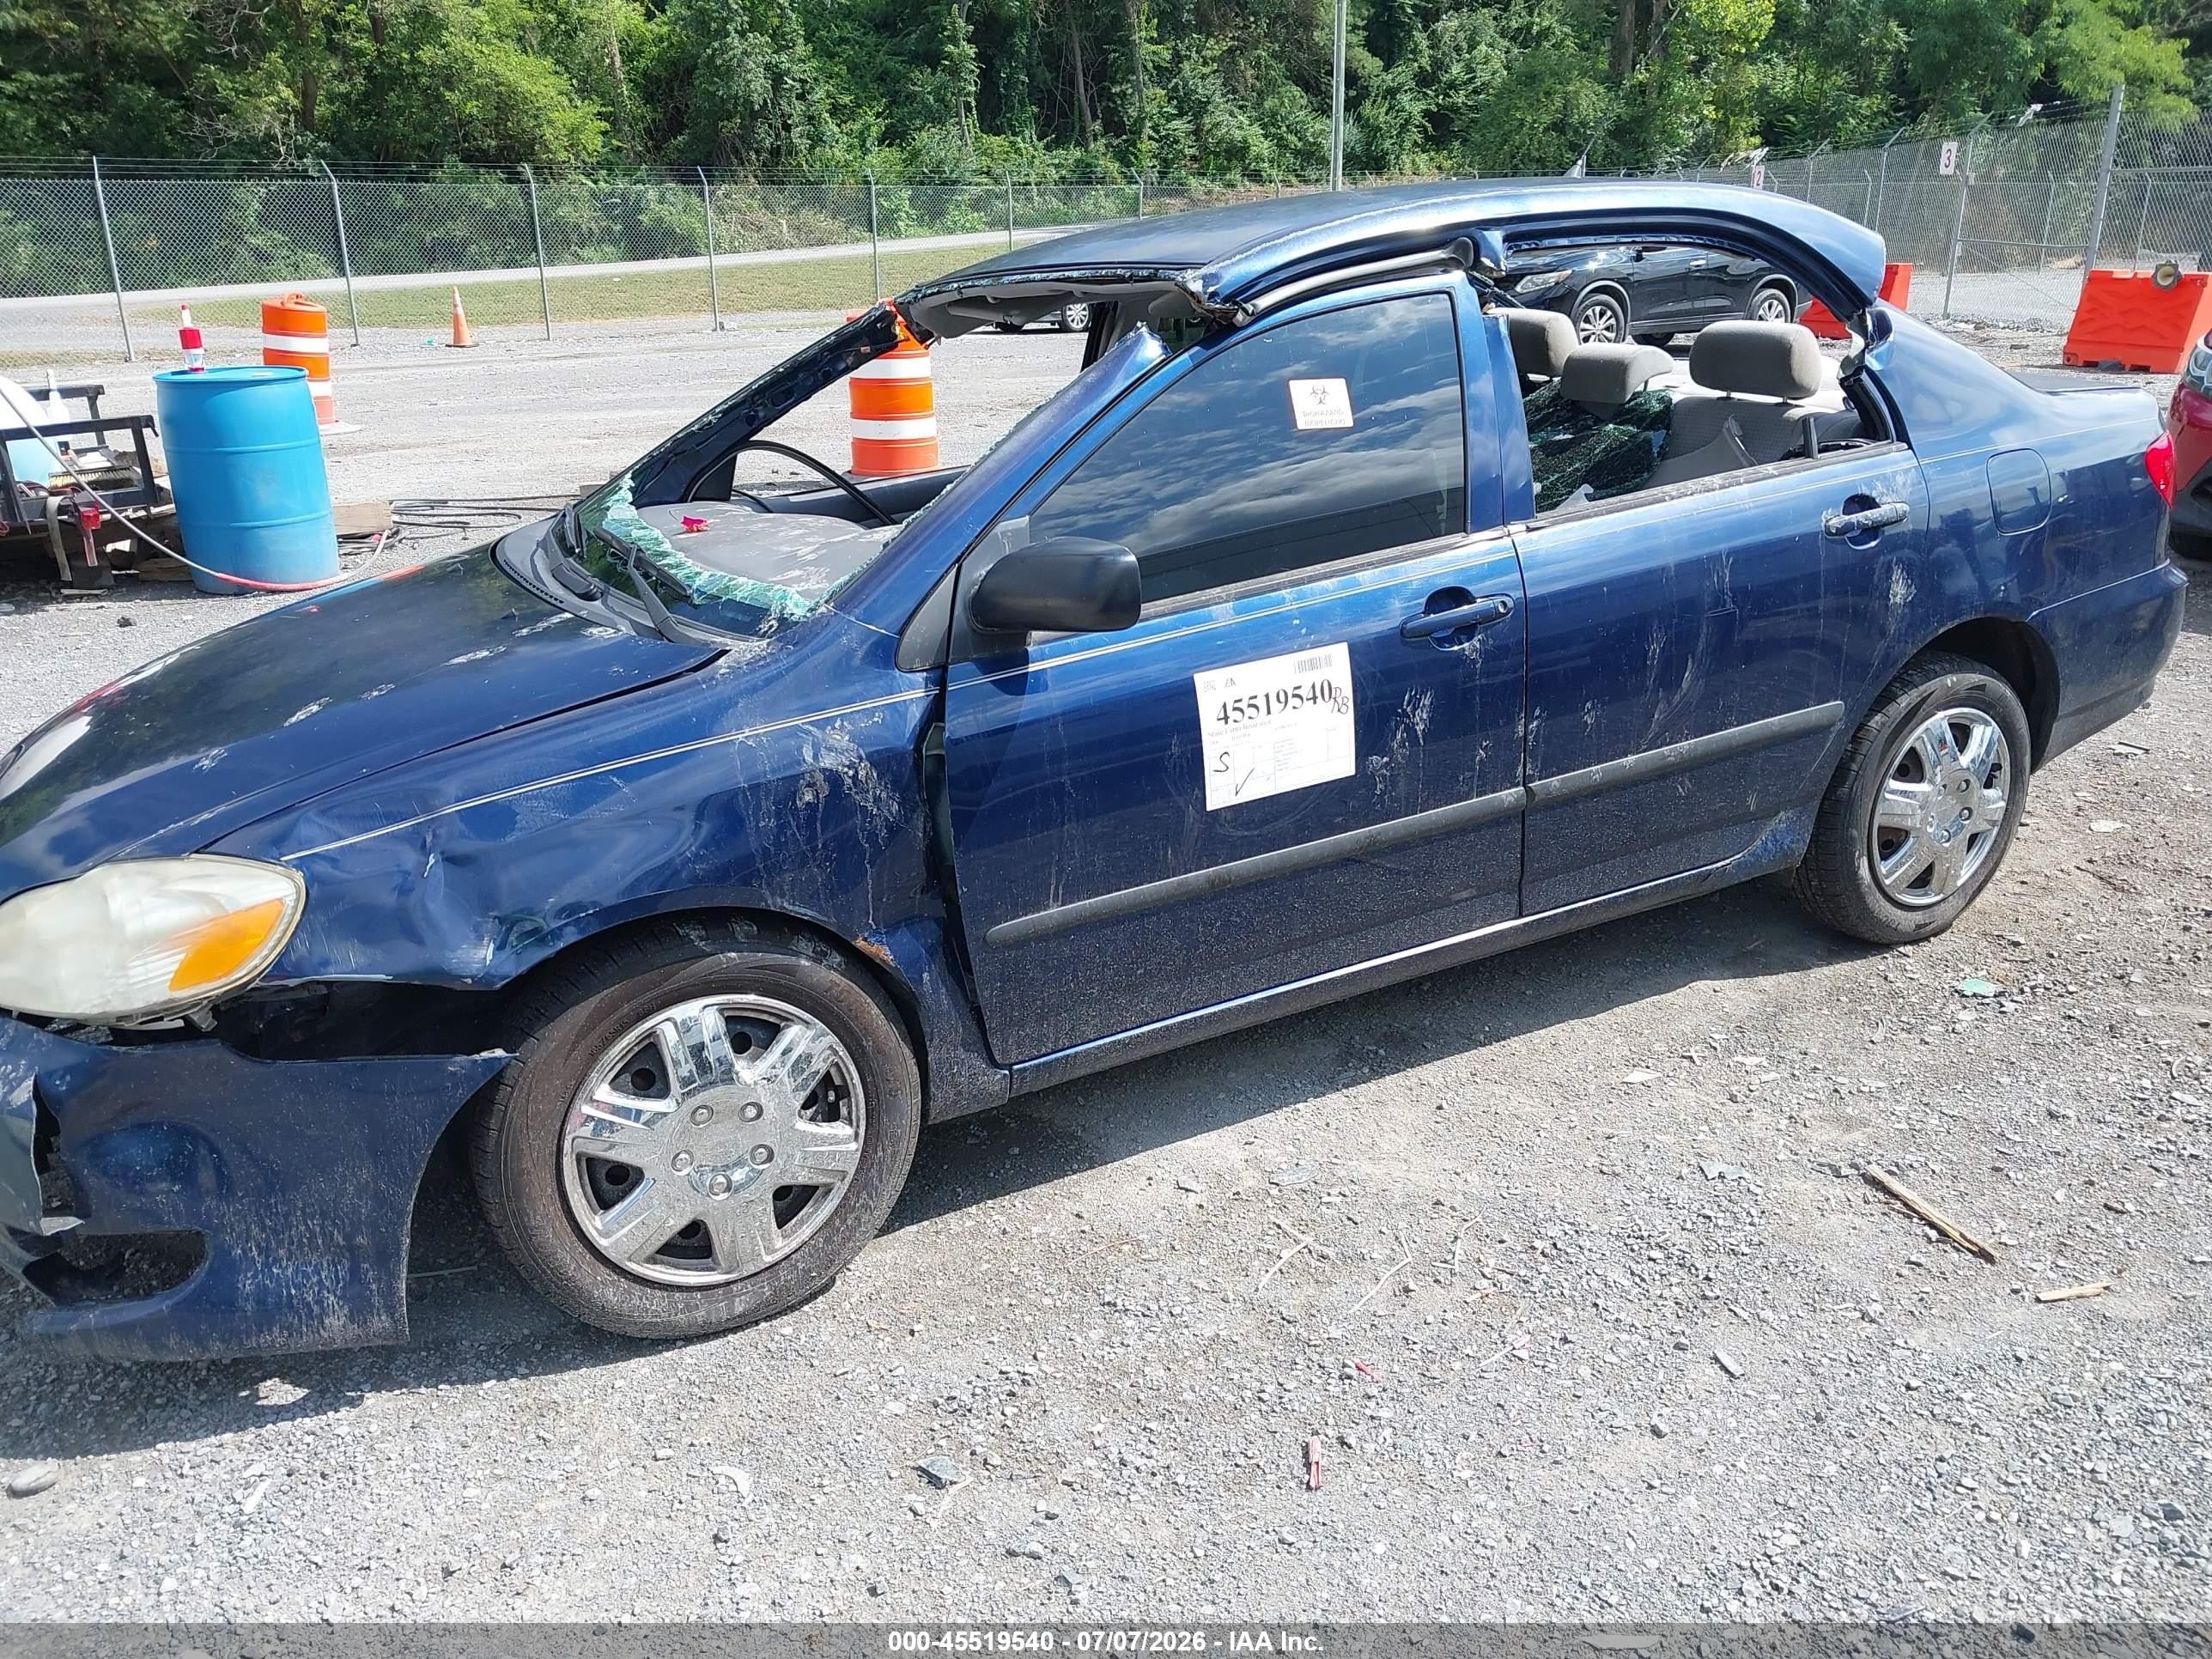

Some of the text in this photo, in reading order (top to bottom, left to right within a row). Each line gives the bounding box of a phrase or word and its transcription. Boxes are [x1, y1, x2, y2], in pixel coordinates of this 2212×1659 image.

[1943, 148, 1952, 168] 3
[1755, 170, 1763, 187] 2
[1216, 678, 1332, 726] 45519540
[1212, 751, 1231, 773] S
